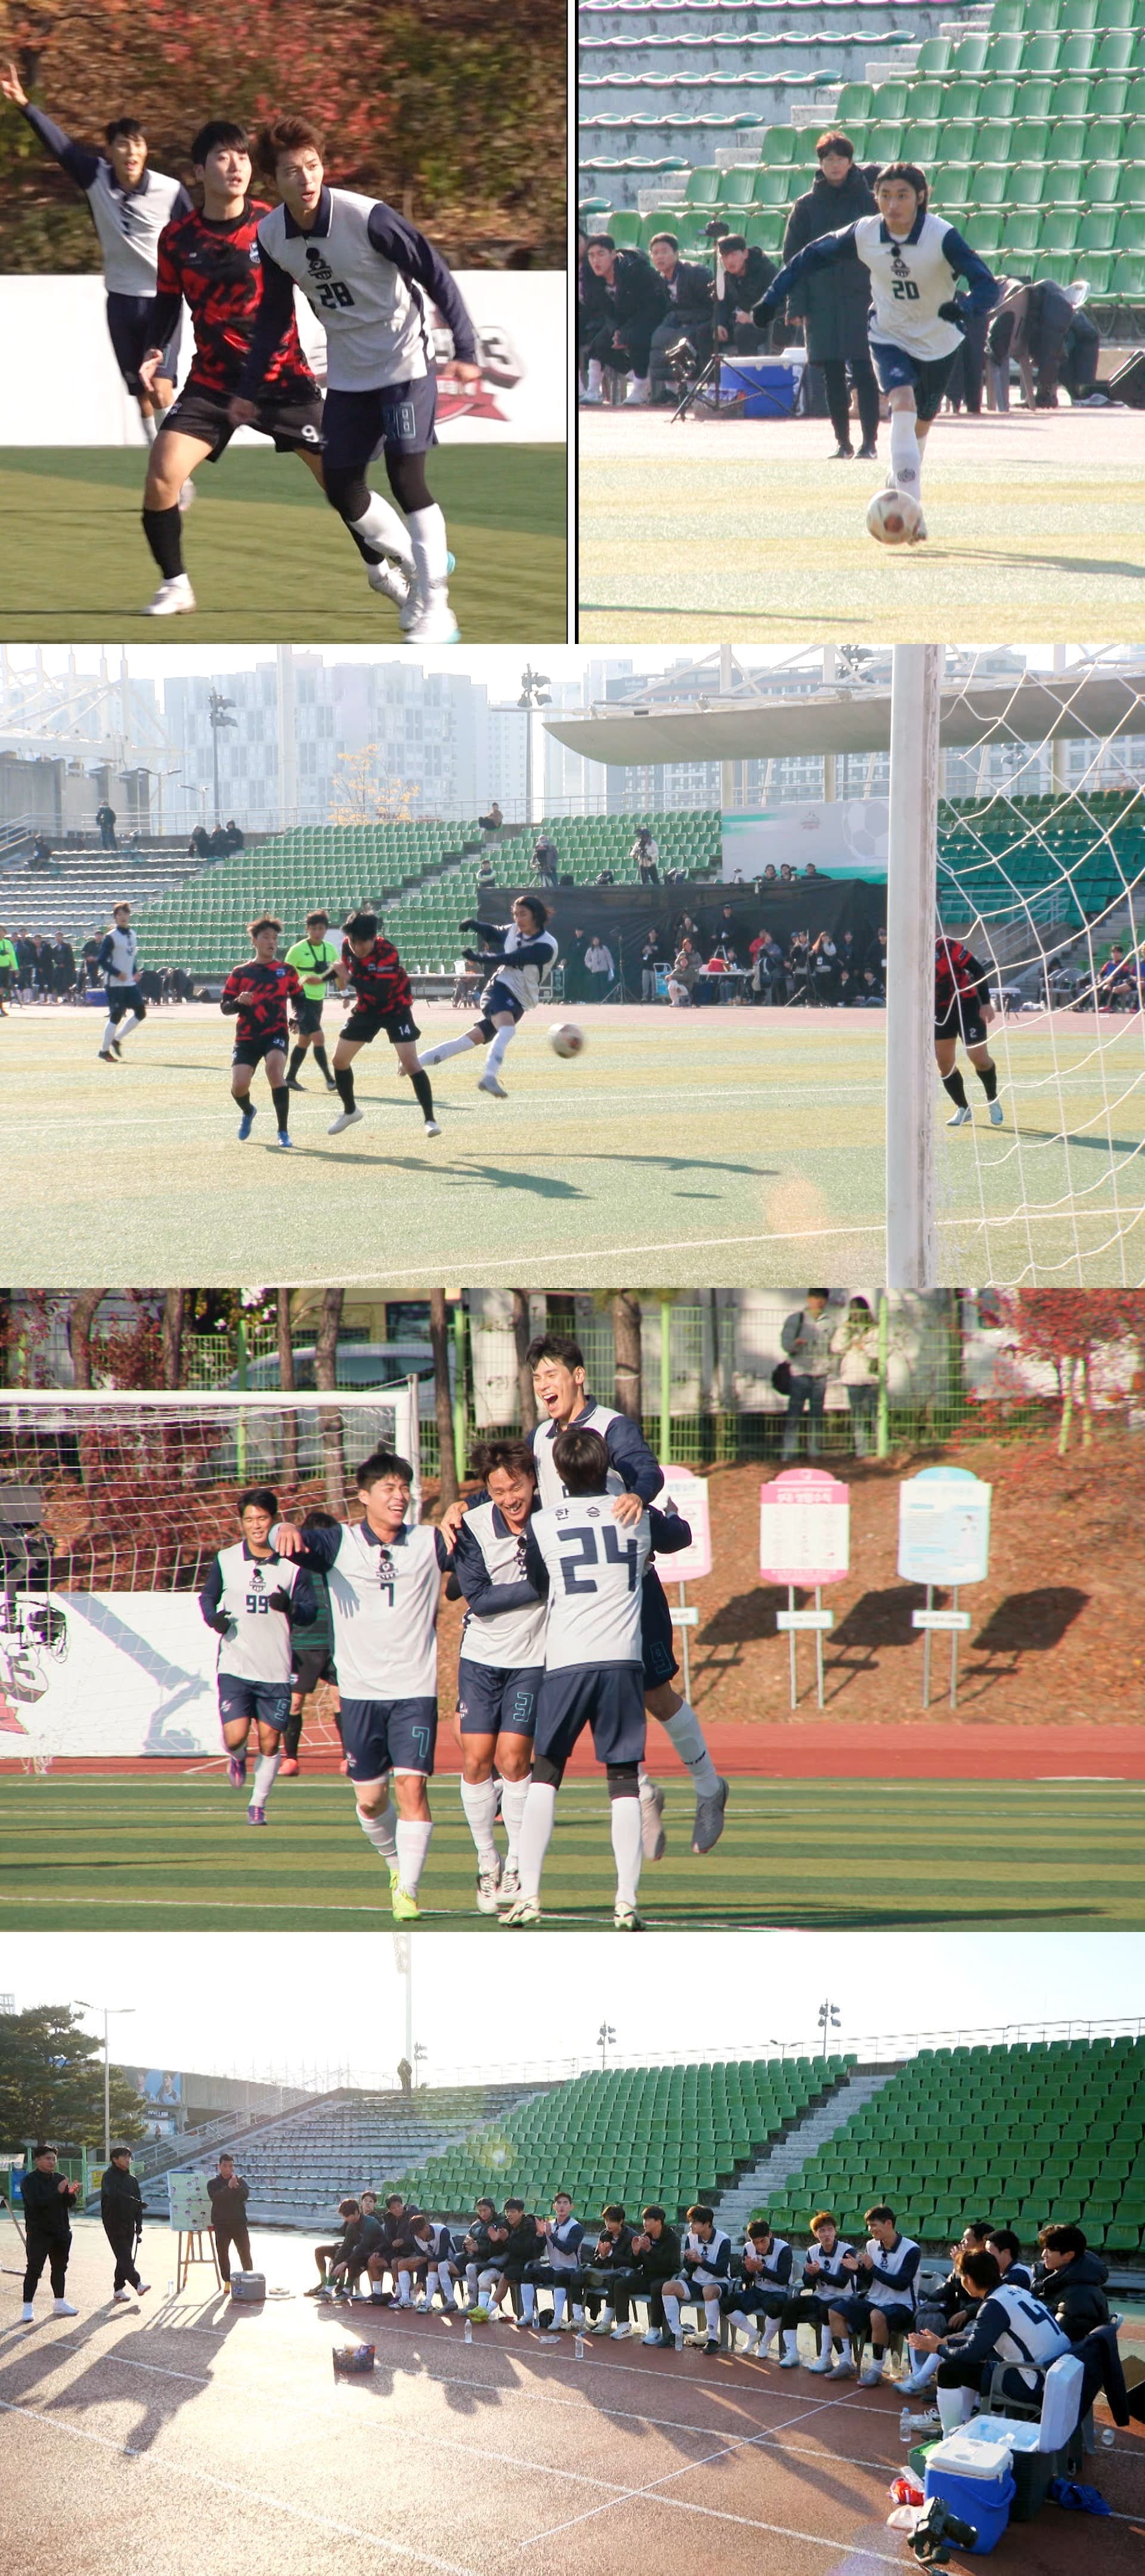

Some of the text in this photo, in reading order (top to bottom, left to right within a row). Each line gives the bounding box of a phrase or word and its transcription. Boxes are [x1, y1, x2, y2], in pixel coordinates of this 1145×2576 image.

[315, 282, 355, 309] 28
[892, 280, 920, 300] 20
[398, 1024, 410, 1036] 14
[968, 1027, 977, 1038] 2
[556, 1525, 638, 1595] 24
[246, 1594, 268, 1614] 99
[380, 1582, 394, 1608] 7
[513, 1691, 534, 1723] 3
[412, 1726, 430, 1758] 7
